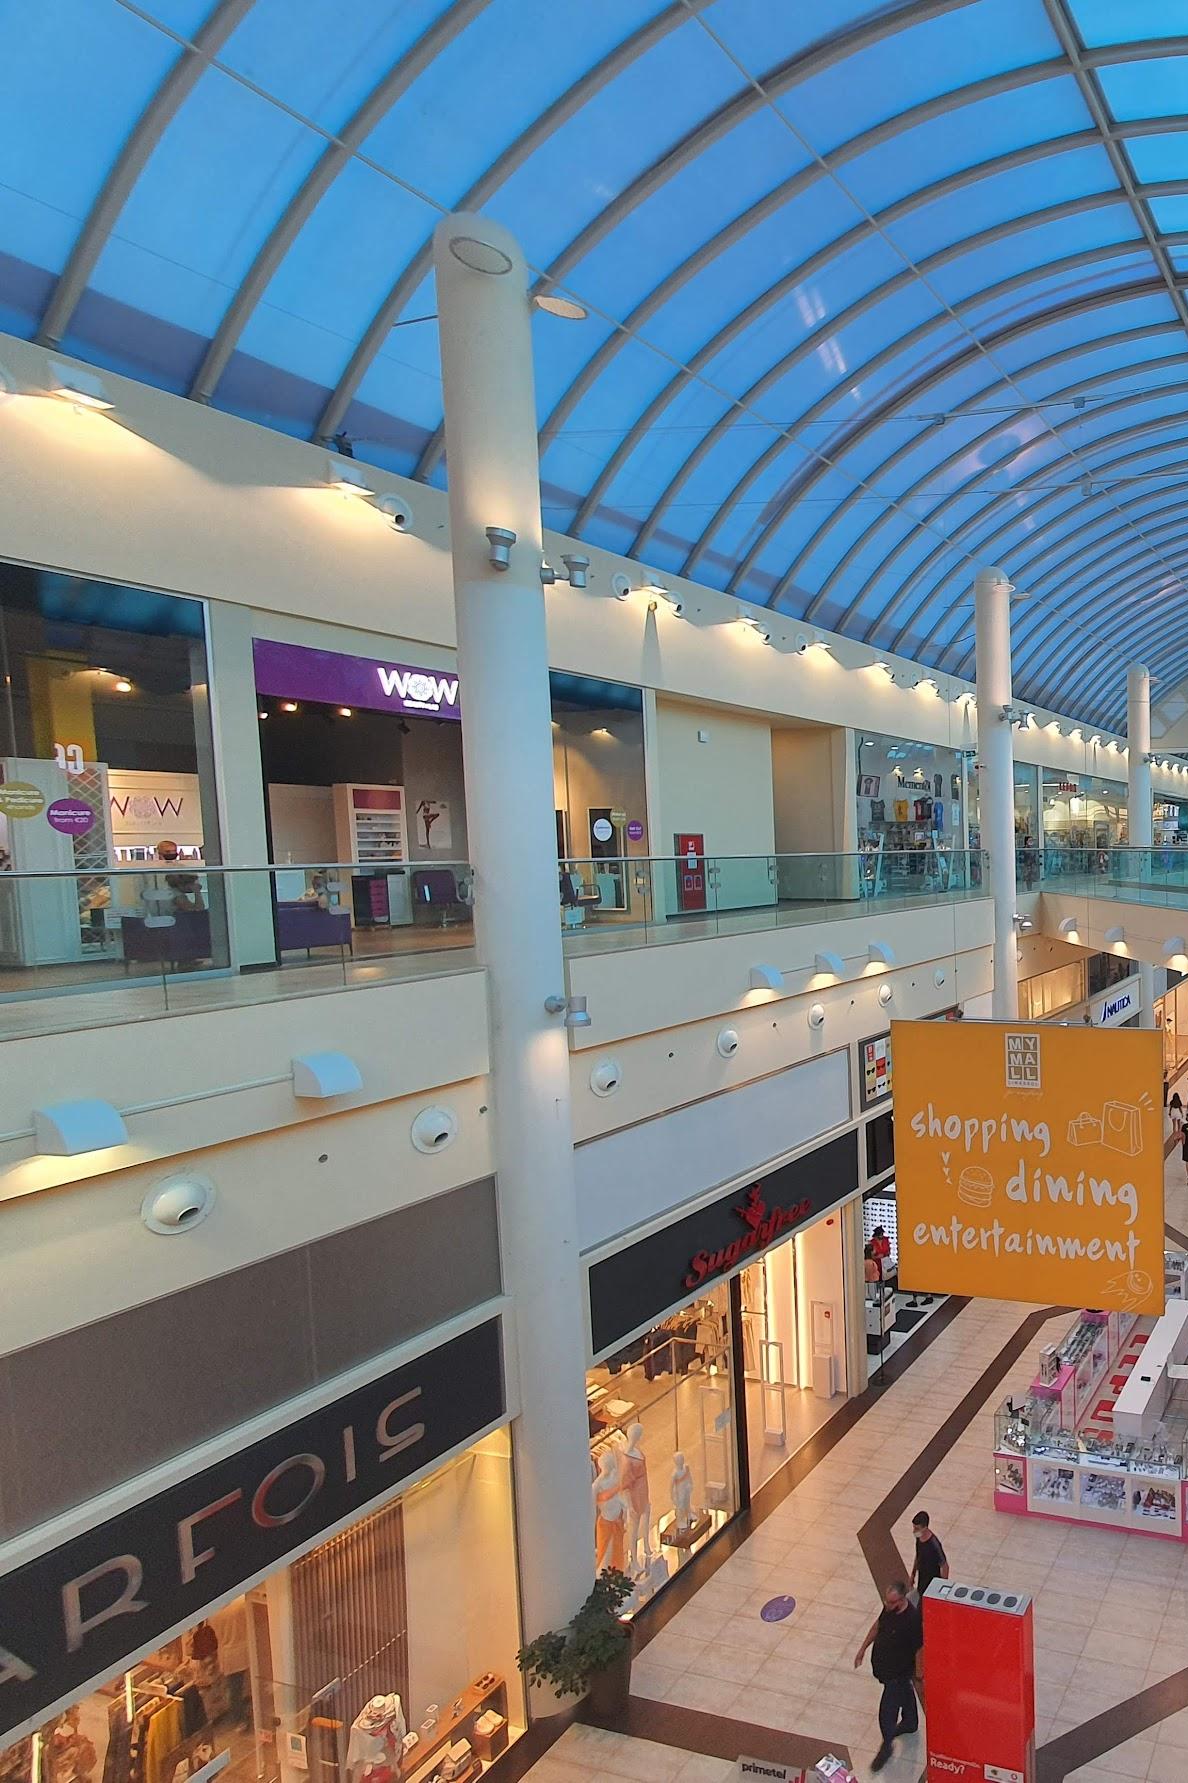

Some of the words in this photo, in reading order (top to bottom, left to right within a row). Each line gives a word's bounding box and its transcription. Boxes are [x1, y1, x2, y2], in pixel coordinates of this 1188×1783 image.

[377, 667, 458, 705] WOW
[50, 808, 91, 817] Manicure
[1008, 1037, 1036, 1051] MY
[911, 1102, 1051, 1157] shopping
[1006, 1158, 1138, 1225] dining
[913, 1216, 1141, 1270] entertainment
[742, 1762, 787, 1780] primetel
[930, 1757, 965, 1775] Ready?
